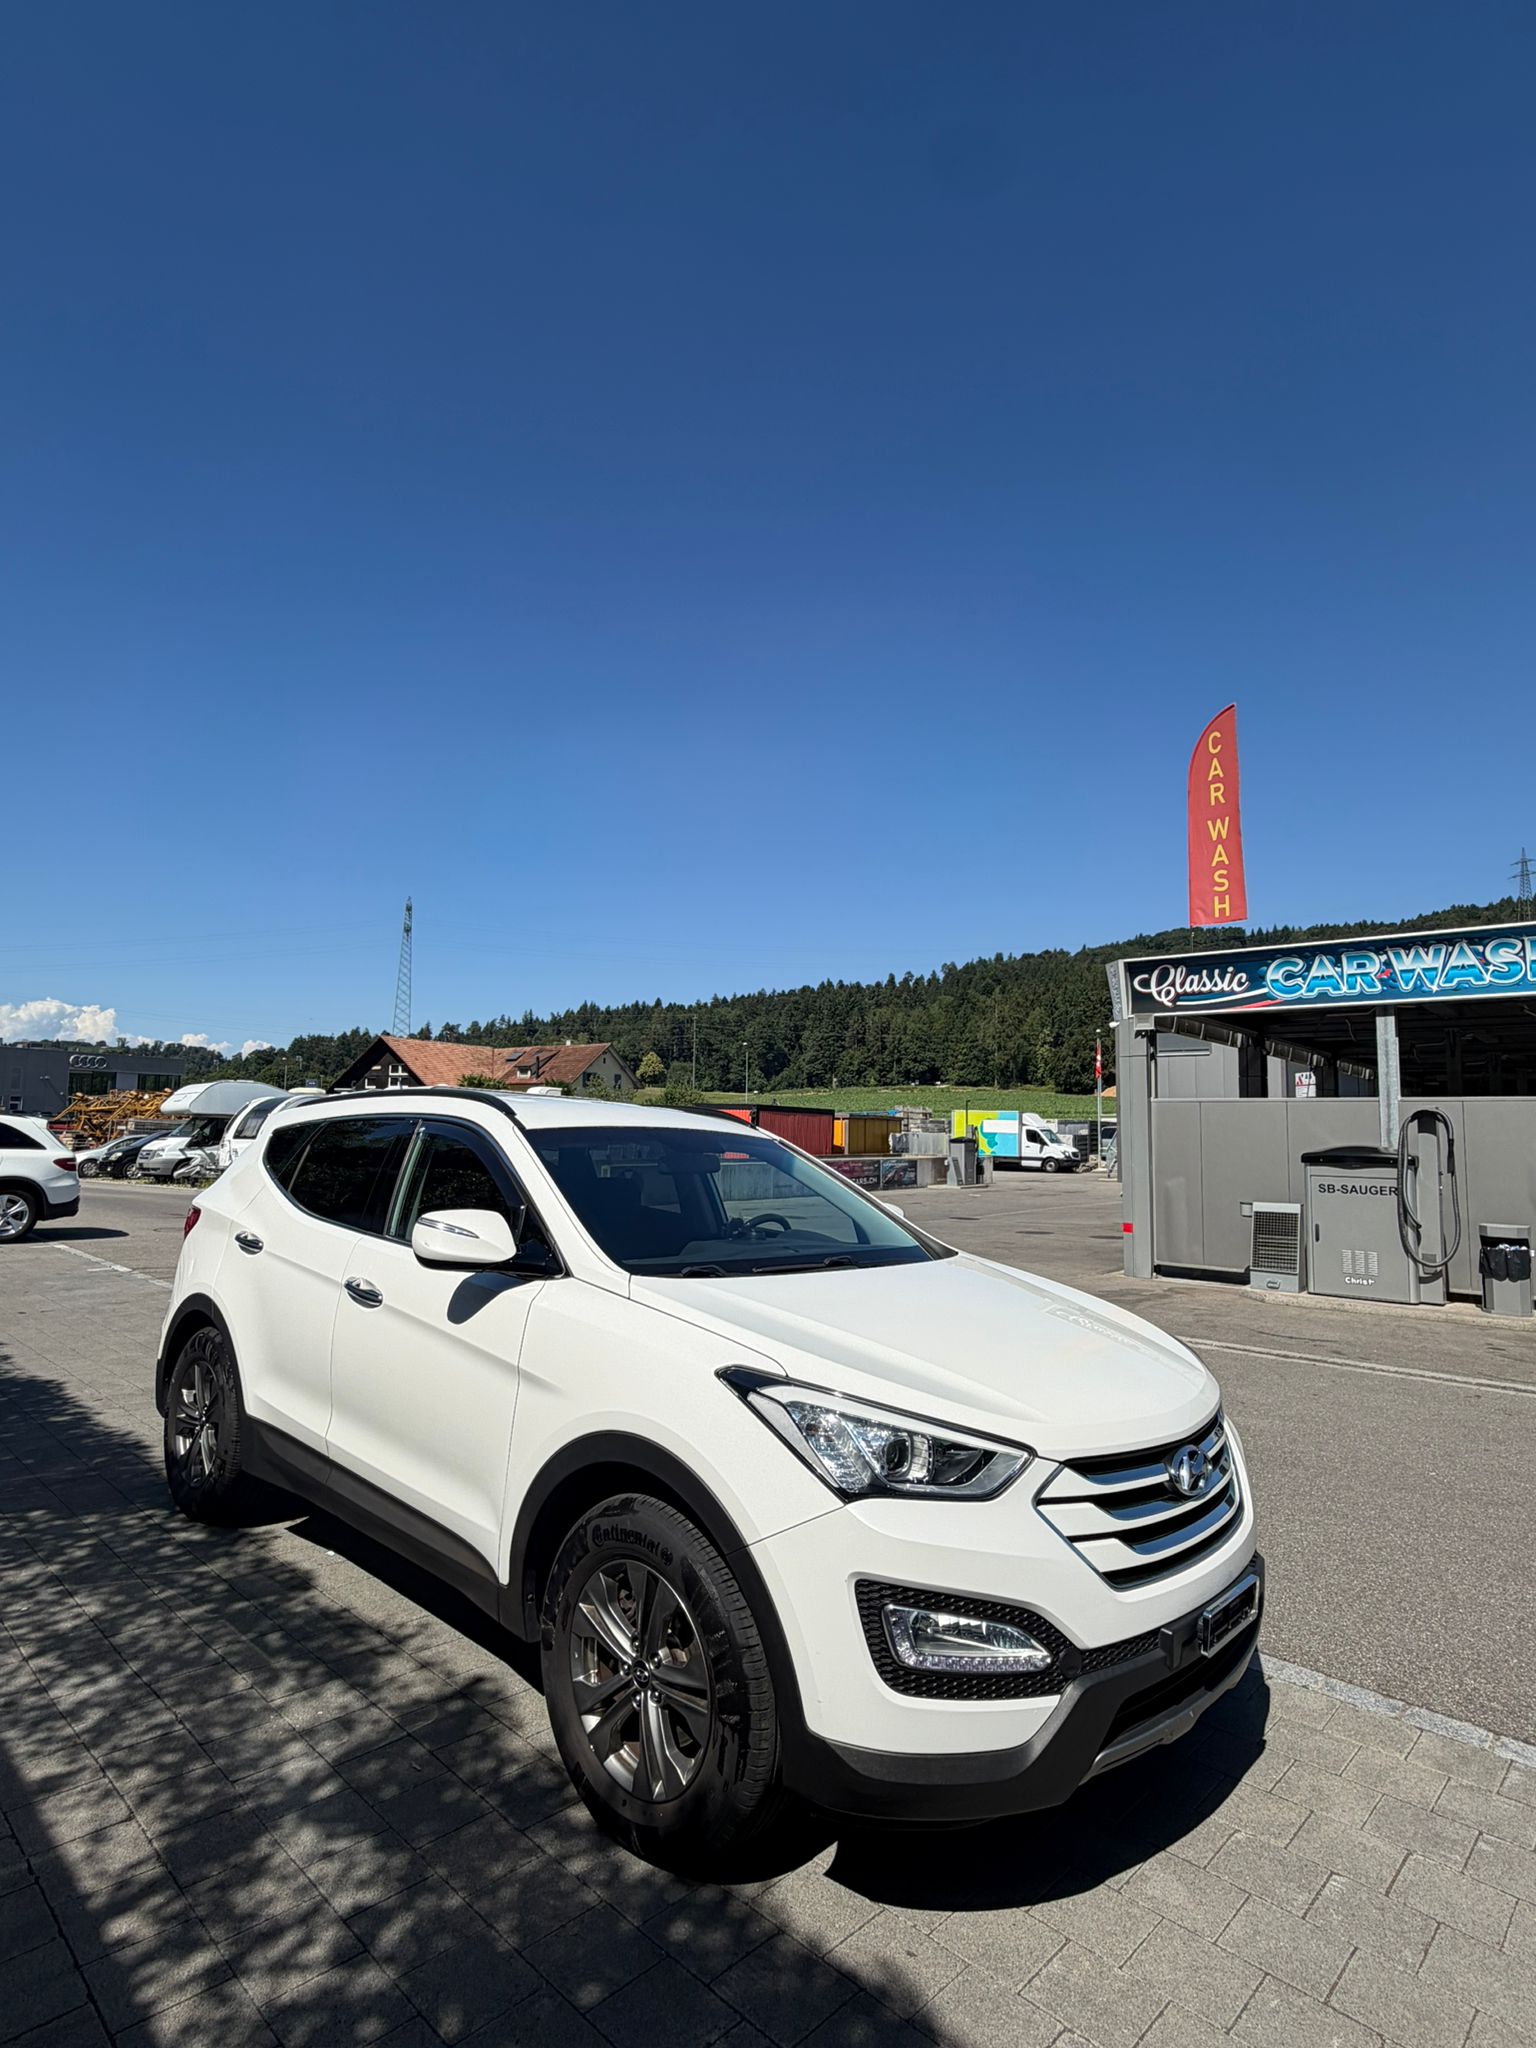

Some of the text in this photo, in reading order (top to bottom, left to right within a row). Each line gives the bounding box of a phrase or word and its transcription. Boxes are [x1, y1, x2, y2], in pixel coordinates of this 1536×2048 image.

[1207, 731, 1230, 918] CAR WASH
[1133, 964, 1249, 1007] Classic
[1318, 1183, 1399, 1196] SB-SAUGER
